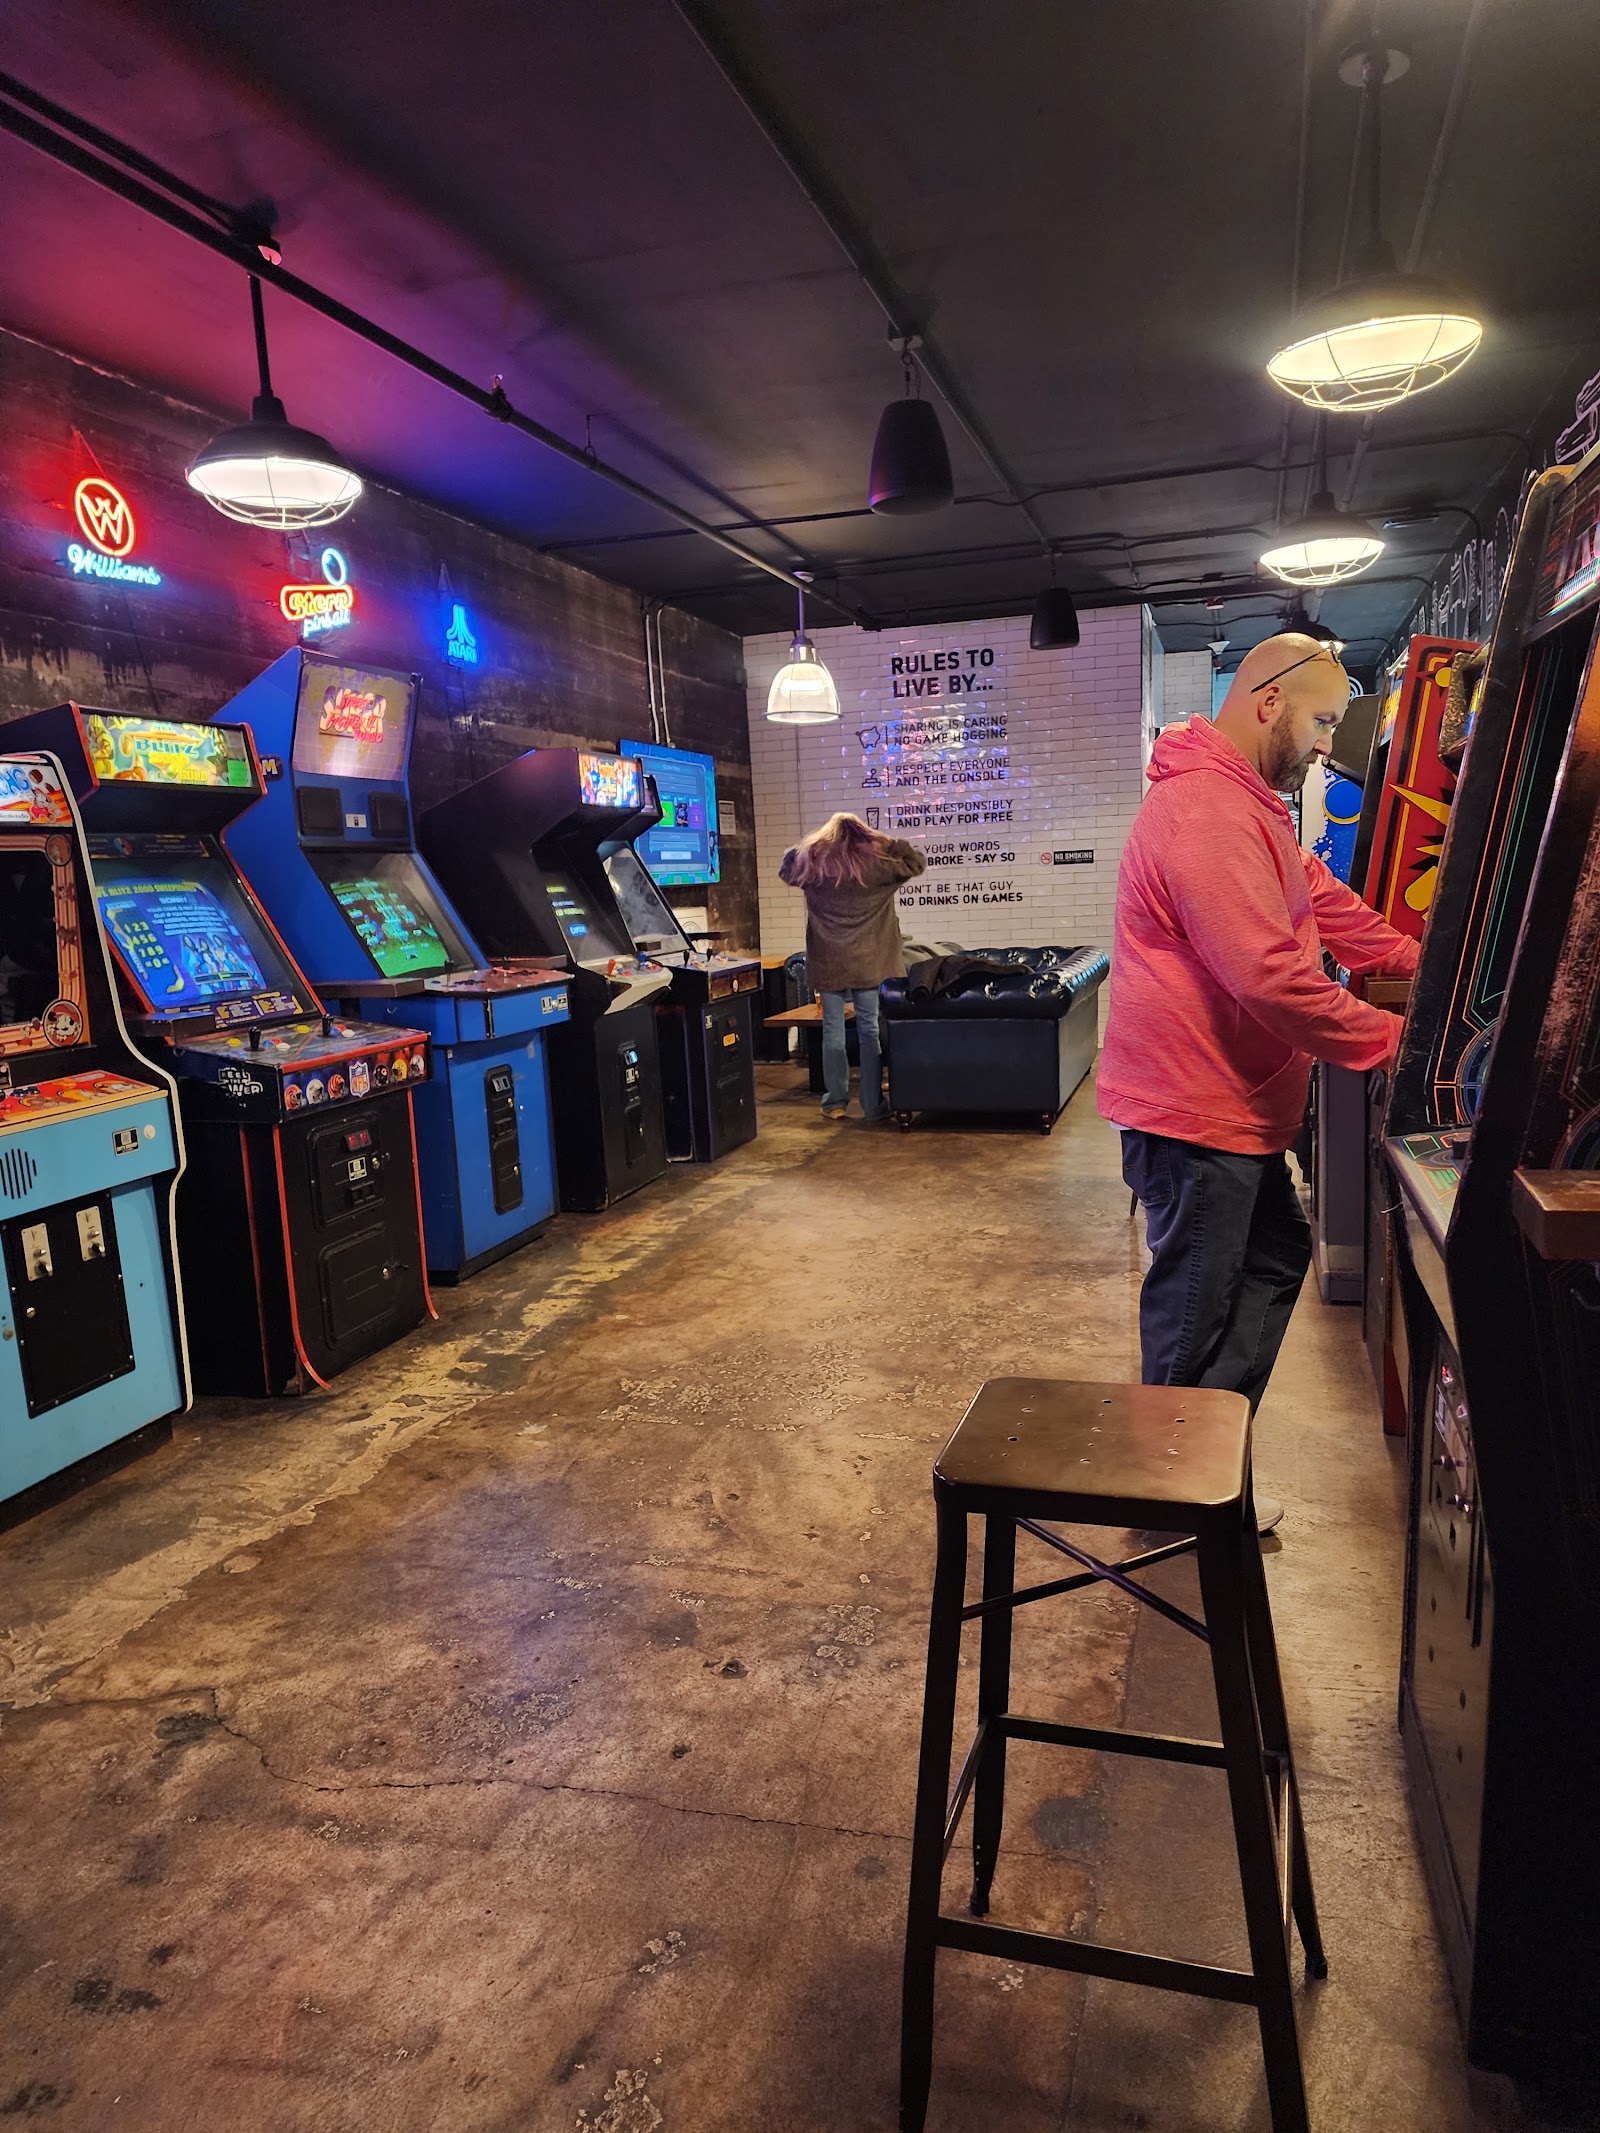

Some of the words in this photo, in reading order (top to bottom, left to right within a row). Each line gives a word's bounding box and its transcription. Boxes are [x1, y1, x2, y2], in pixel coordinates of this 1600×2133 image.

[68, 543, 161, 585] Williams
[289, 591, 350, 617] Stern
[303, 607, 351, 638] pinball
[448, 640, 478, 663] ATARI
[891, 652, 960, 675] RULES
[966, 648, 994, 668] TO
[893, 677, 939, 698] LIVE
[949, 673, 994, 693] BY...
[894, 720, 944, 733] SHARING
[949, 719, 959, 730] IS
[963, 715, 1007, 728] CARING
[894, 735, 910, 746] NO
[915, 732, 947, 744] GAME
[953, 728, 1007, 742] HOGGING
[136, 738, 198, 755] BLITZ
[895, 762, 946, 775] RESPECT
[949, 757, 1010, 771] EVERYONE
[895, 776, 920, 787] AND
[924, 774, 947, 785] THE
[952, 770, 1005, 783] CONSOLE
[896, 805, 931, 816] DRINK
[936, 799, 1014, 813] RESPONSIBLY
[897, 817, 920, 828] AND
[925, 815, 953, 826] PLAY
[957, 813, 979, 824] FOR
[984, 811, 1013, 822] FREE
[924, 843, 954, 854] YOUR
[959, 840, 1000, 852] WORDS
[1065, 851, 1093, 860] SMOKING
[927, 855, 964, 866] BROKE
[974, 853, 997, 863] SAY
[1000, 852, 1015, 862] SO
[899, 884, 931, 895] DON'T
[936, 883, 951, 893] BE
[956, 882, 984, 892] THAT
[989, 880, 1014, 891] GUY
[899, 897, 914, 907] NO
[919, 895, 959, 906] DRINKS
[963, 894, 978, 904] ON
[983, 892, 1023, 904] GAMES
